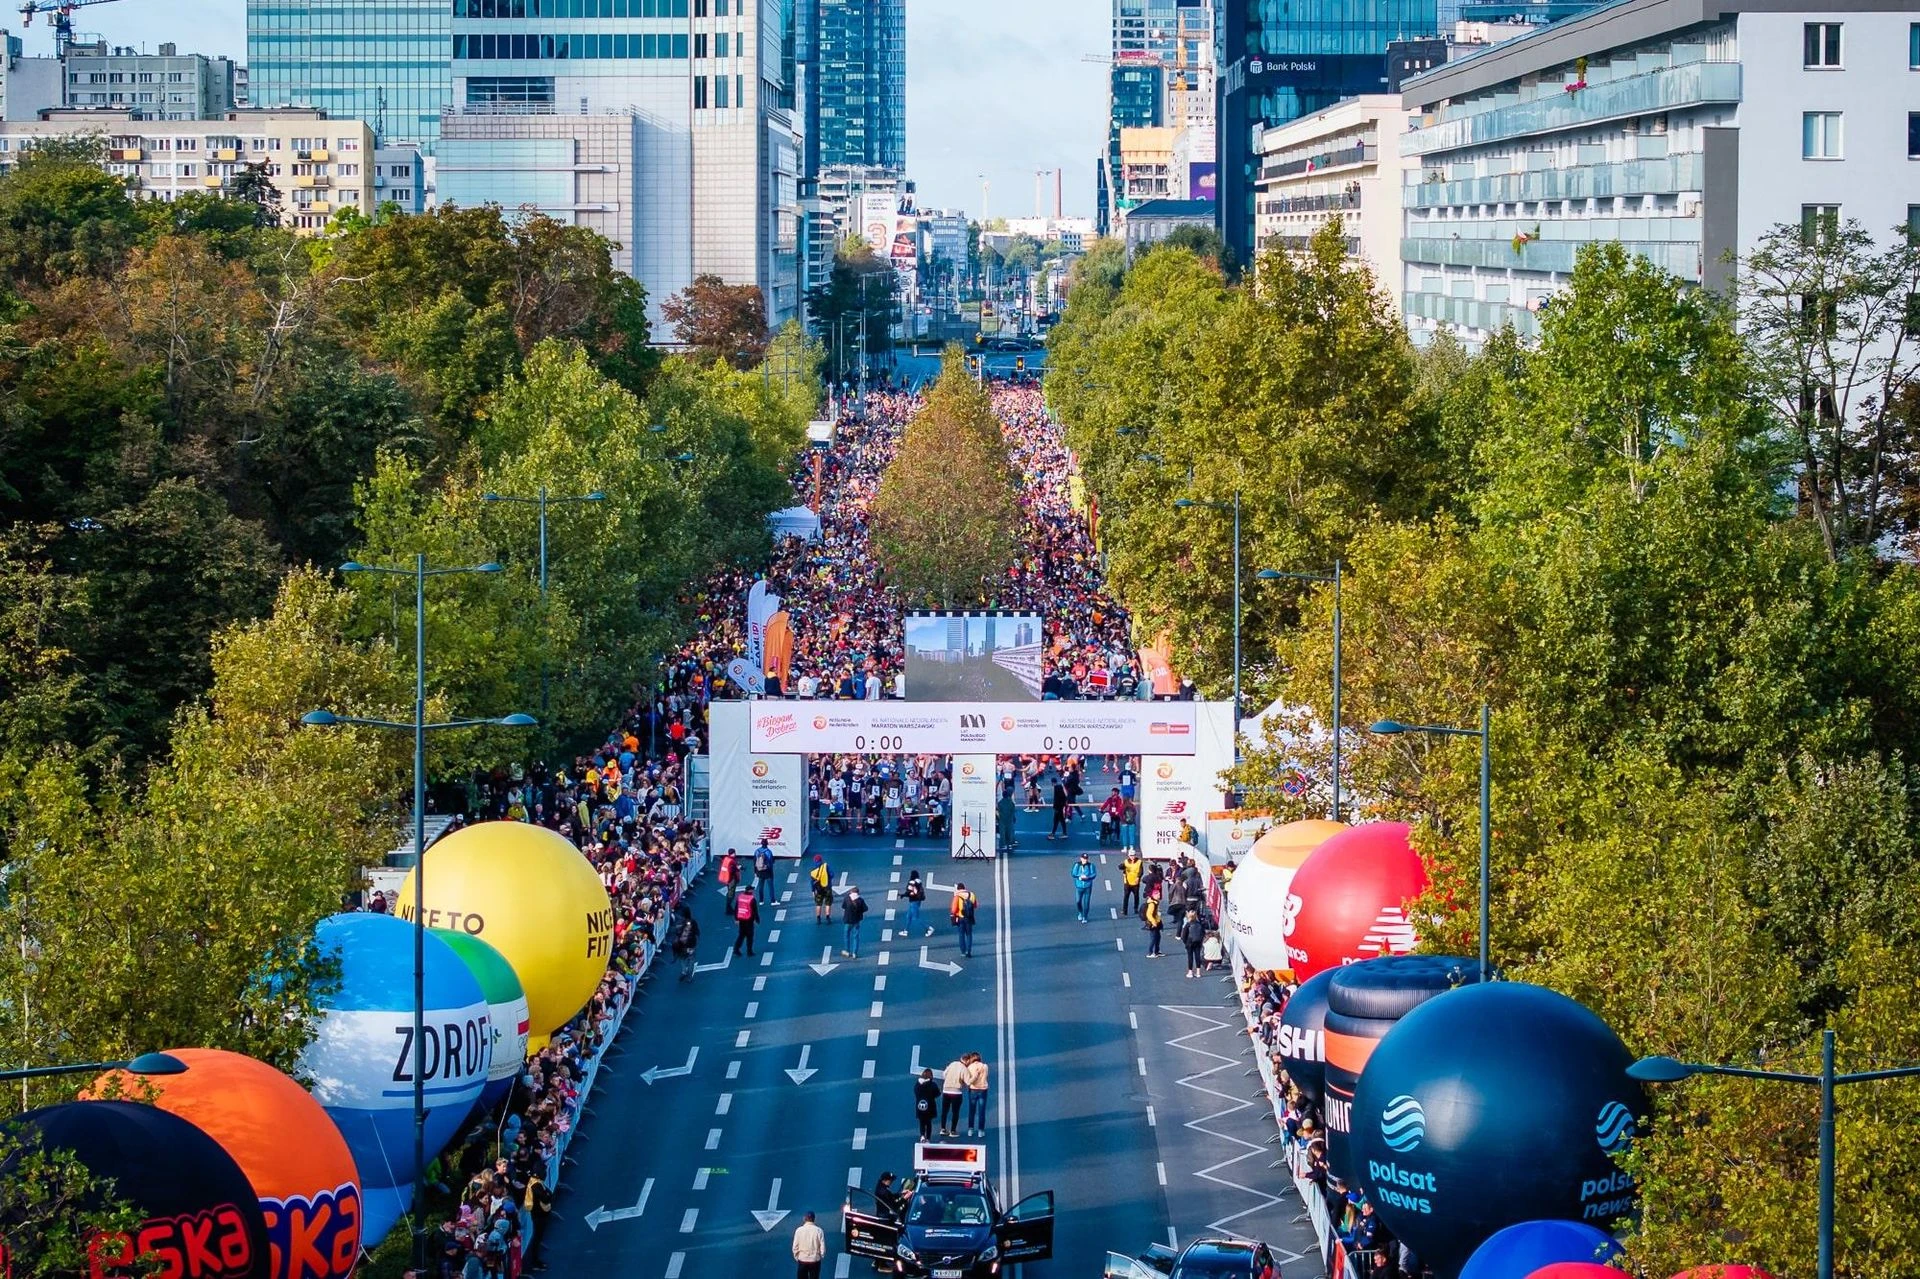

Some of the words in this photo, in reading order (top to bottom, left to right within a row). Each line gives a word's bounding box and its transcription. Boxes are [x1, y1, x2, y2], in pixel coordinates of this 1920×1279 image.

[1267, 61, 1288, 71] Bank
[1290, 61, 1316, 71] Polski
[1156, 830, 1177, 838] NICE
[587, 934, 609, 958] FIT
[1369, 1159, 1437, 1193] polsat
[1378, 1185, 1432, 1214] news
